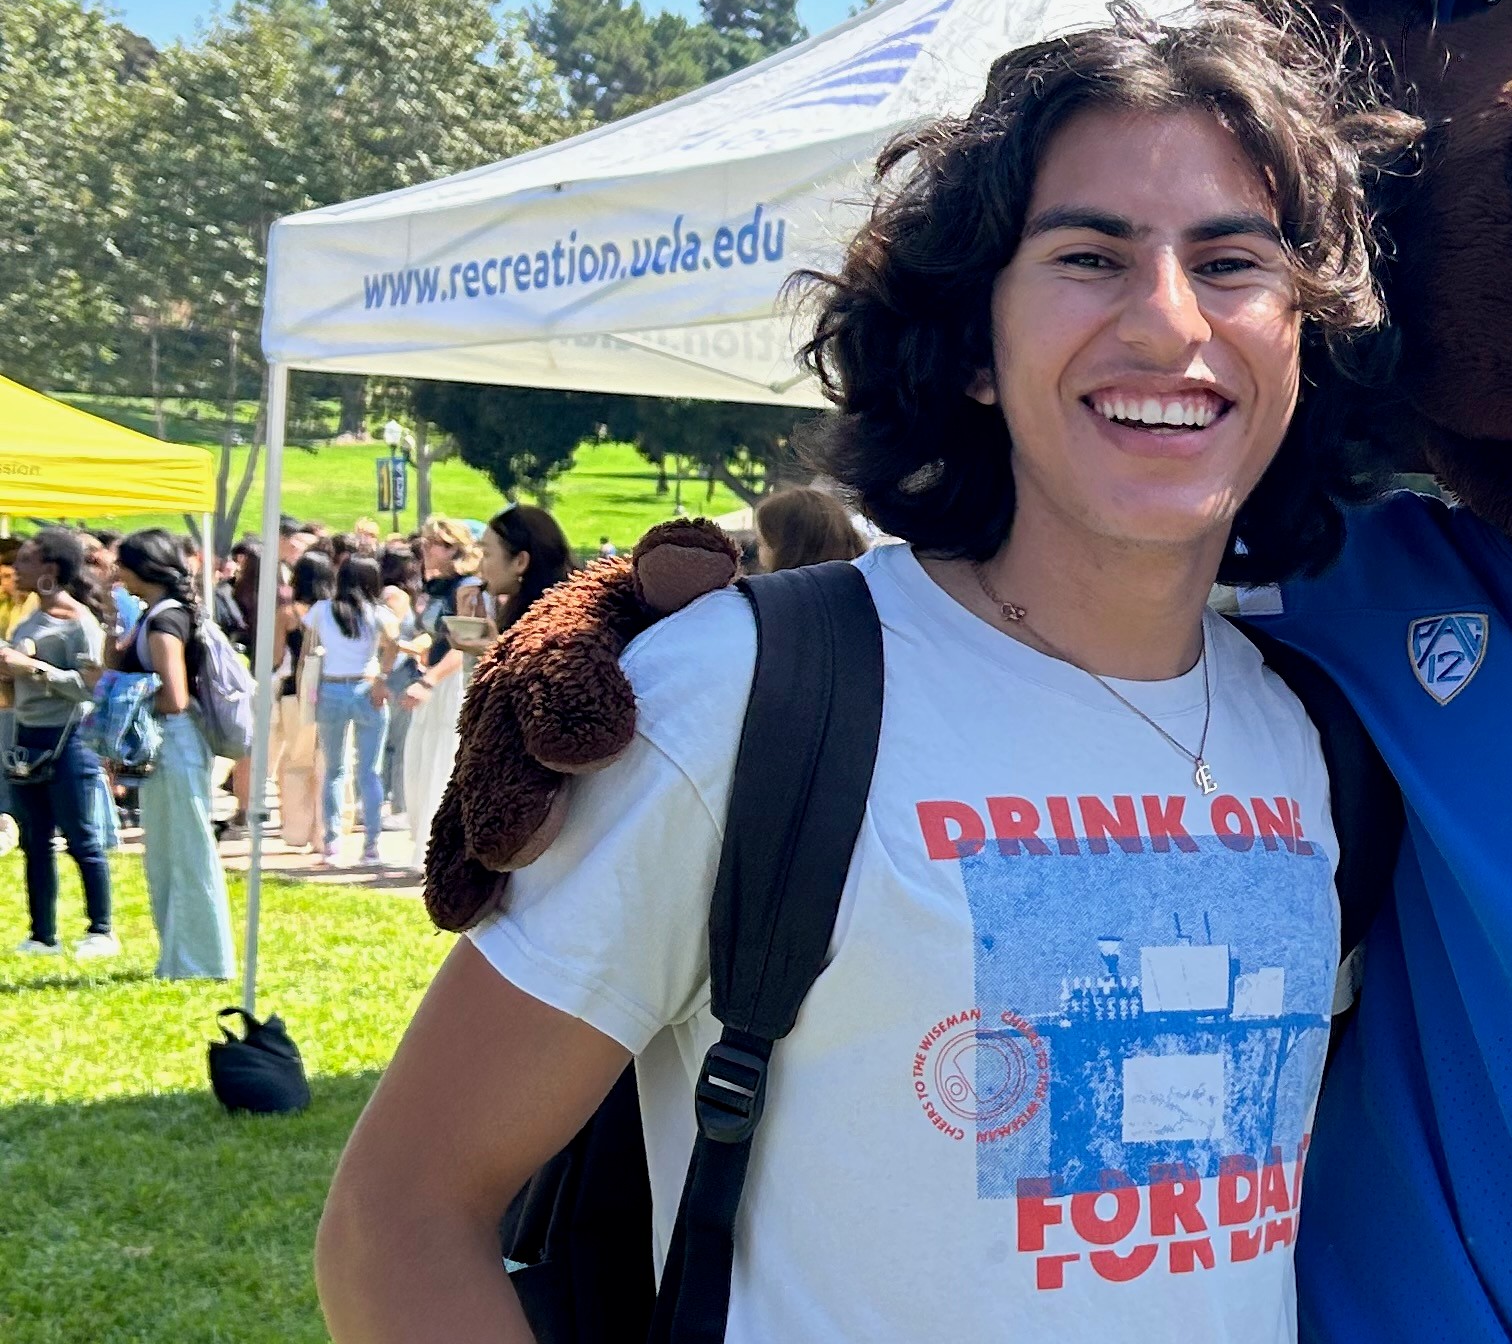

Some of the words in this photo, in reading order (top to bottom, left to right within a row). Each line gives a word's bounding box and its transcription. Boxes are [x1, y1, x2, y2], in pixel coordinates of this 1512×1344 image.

[363, 203, 786, 310] www.recreation.ucla.edu
[1412, 617, 1482, 669] PAC
[1427, 650, 1465, 684] 12
[915, 794, 1201, 861] DRINK
[919, 1008, 981, 1052] WISEMAN
[912, 1052, 927, 1077] THE
[914, 1080, 929, 1100] TO
[922, 1101, 965, 1141] CHEERS
[1016, 1162, 1208, 1253] FOR
